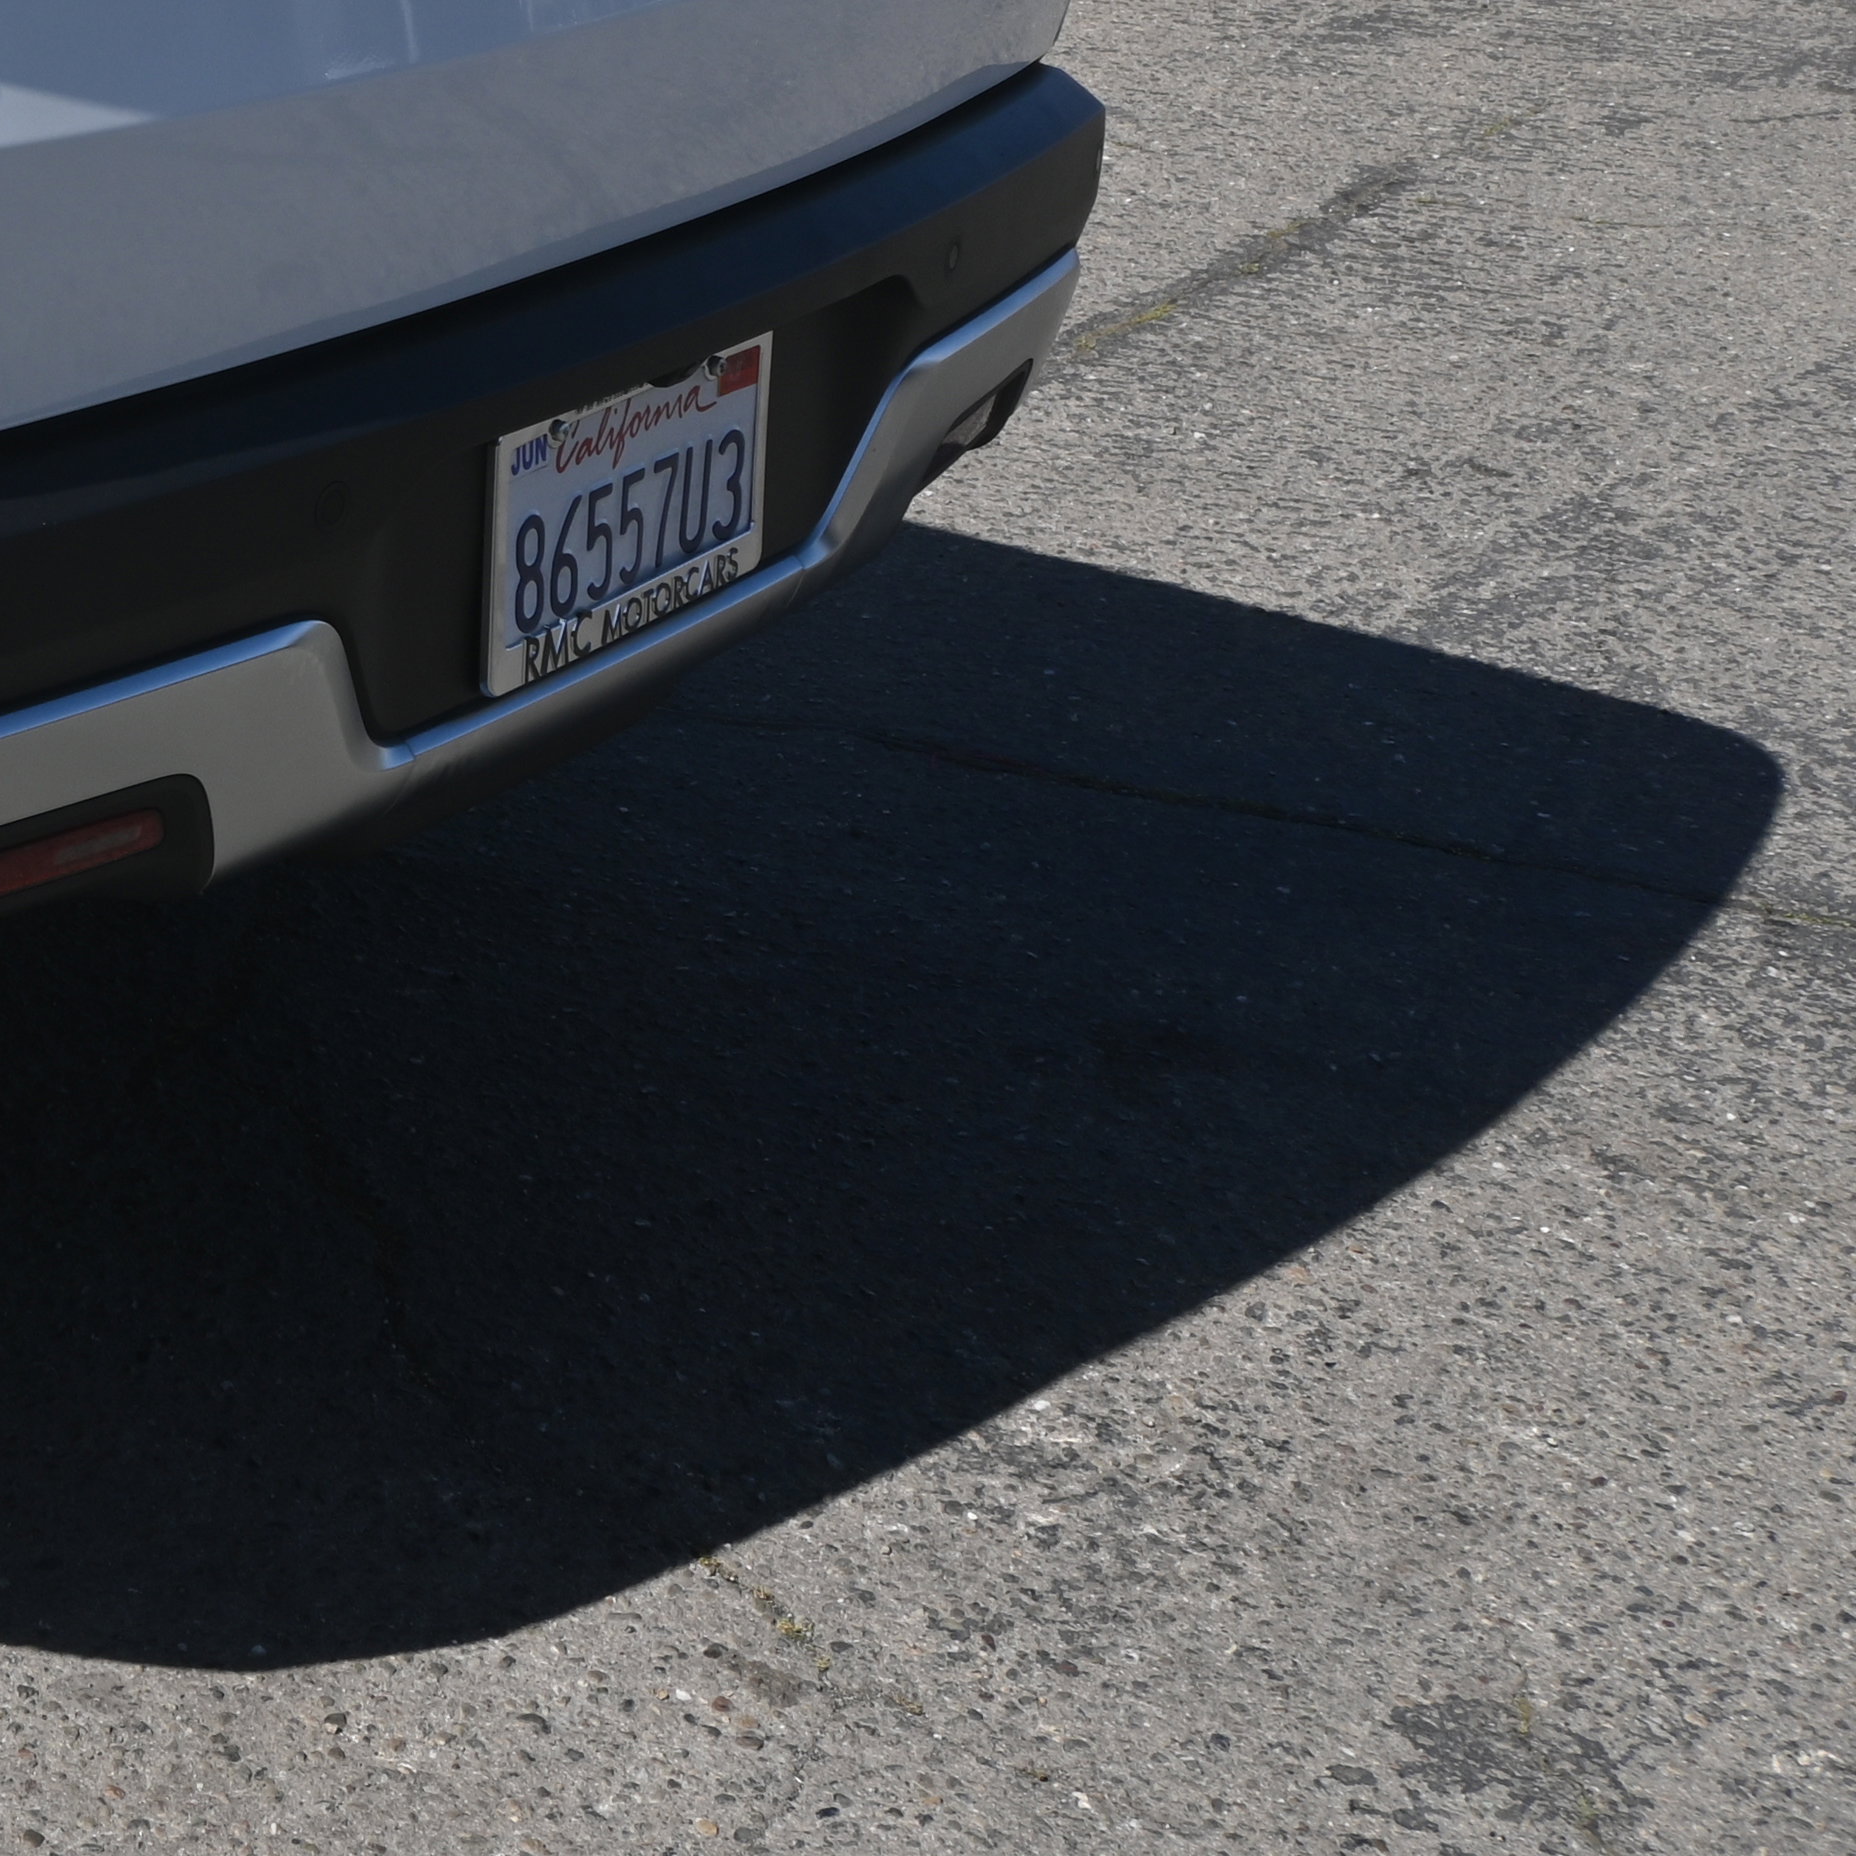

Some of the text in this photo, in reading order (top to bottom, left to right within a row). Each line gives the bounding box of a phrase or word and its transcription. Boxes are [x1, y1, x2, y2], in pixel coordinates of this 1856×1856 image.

[511, 434, 548, 476] JUN
[556, 385, 717, 474] California
[514, 429, 746, 634] 86557U3
[524, 547, 740, 683] RMC MOTORCARS
